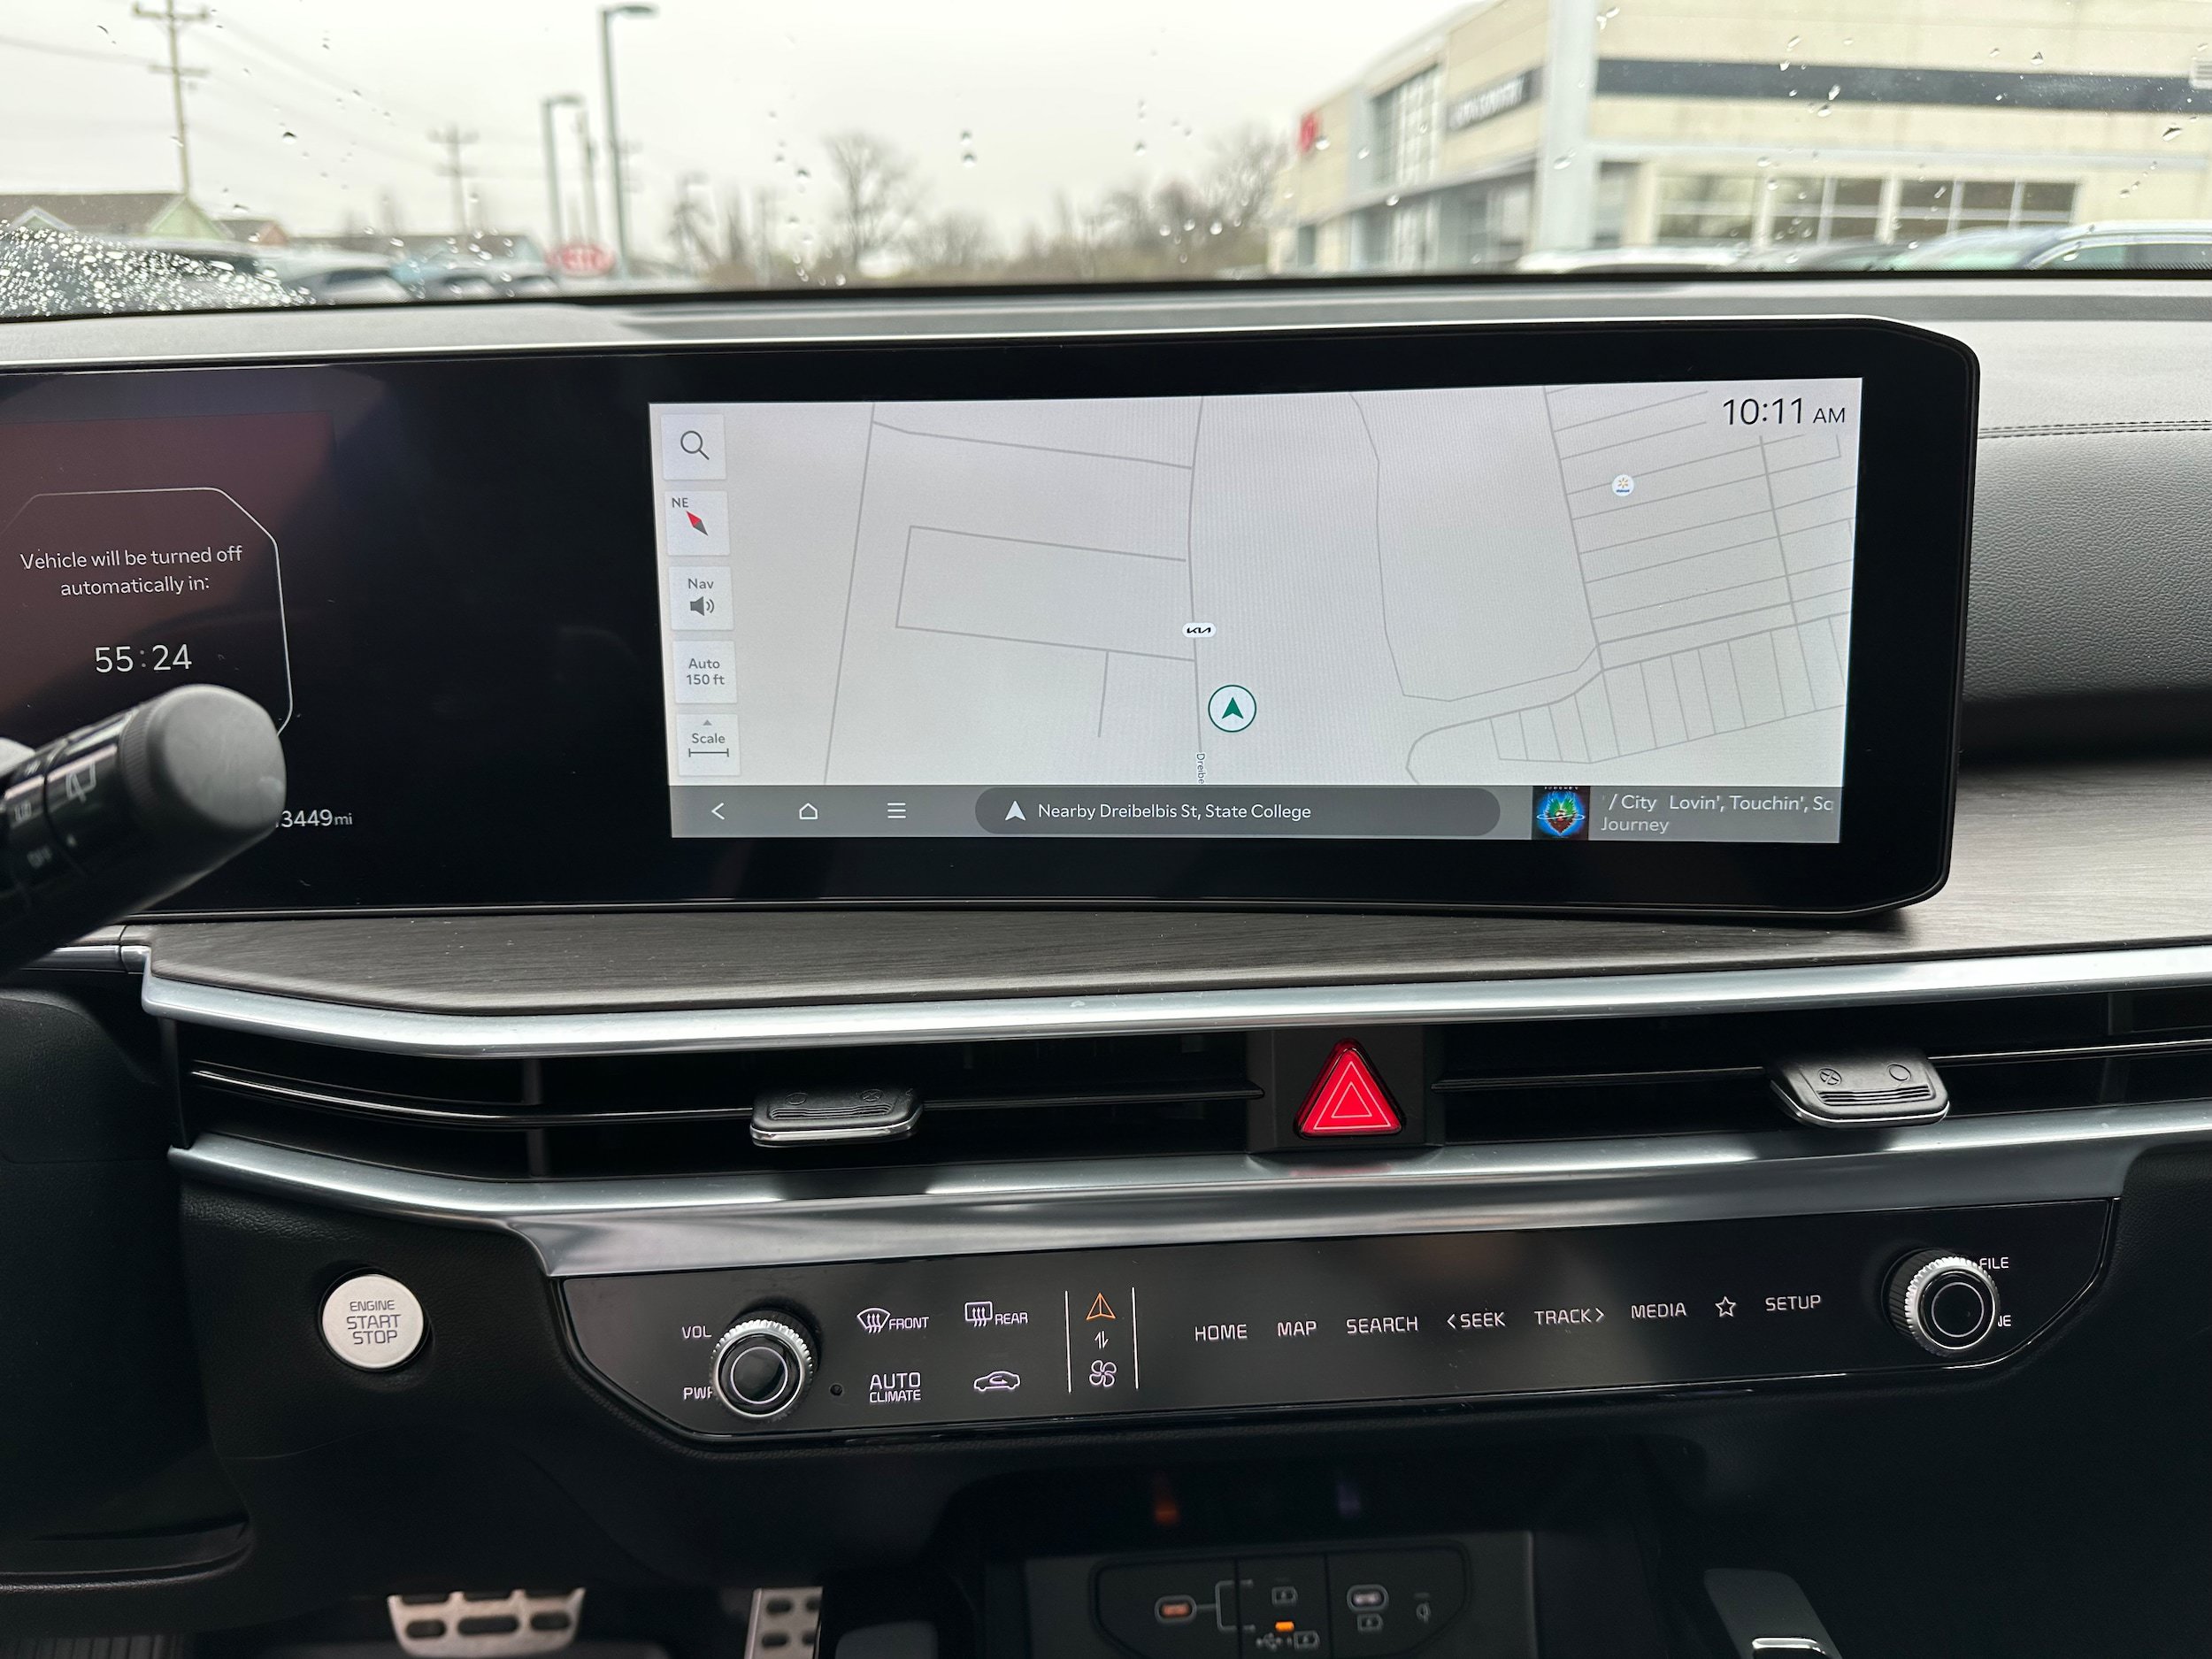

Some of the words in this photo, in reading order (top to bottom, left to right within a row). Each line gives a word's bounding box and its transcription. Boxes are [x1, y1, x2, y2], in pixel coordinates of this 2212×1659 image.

[1723, 397, 1802, 426] 10:11
[1812, 407, 1846, 424] AM
[672, 497, 689, 508] NE
[20, 550, 87, 570] Vehicle
[91, 550, 119, 566] will
[125, 550, 146, 565] be
[150, 547, 211, 564] turned
[216, 544, 243, 563] off
[61, 576, 184, 595] automatically
[188, 576, 209, 590] in:
[687, 579, 714, 589] Nav
[96, 644, 192, 672] 55:24
[687, 657, 721, 670] Auto
[686, 673, 710, 686] 150
[712, 673, 726, 686] ft
[691, 733, 726, 745] Scale
[1622, 795, 1656, 811] City
[1671, 795, 1724, 812] Lovin',
[1729, 795, 1808, 812] Touchin',
[1040, 804, 1095, 820] Nearby
[1101, 804, 1177, 818] Dreibelbis
[1181, 804, 1201, 820] St,
[1206, 804, 1247, 818] State
[1251, 804, 1310, 821] College
[1601, 817, 1669, 833] Journey
[1979, 1256, 2009, 1270] FILE
[350, 1300, 395, 1311] ENGINE
[1632, 1302, 1686, 1318] MEDIA
[1766, 1295, 1820, 1310] SETUP
[347, 1315, 401, 1329] START
[889, 1317, 929, 1330] FRONT
[995, 1312, 1027, 1325] REAR
[1461, 1312, 1505, 1327] SEEK
[1534, 1309, 1591, 1325] TRACK
[682, 1326, 711, 1339] VOL
[1195, 1325, 1247, 1340] HOME
[1278, 1321, 1316, 1336] MAP
[1347, 1317, 1417, 1333] SEARCH
[353, 1330, 397, 1344] STOP
[870, 1372, 921, 1391] AUTO
[870, 1389, 921, 1403] CLIMATE
